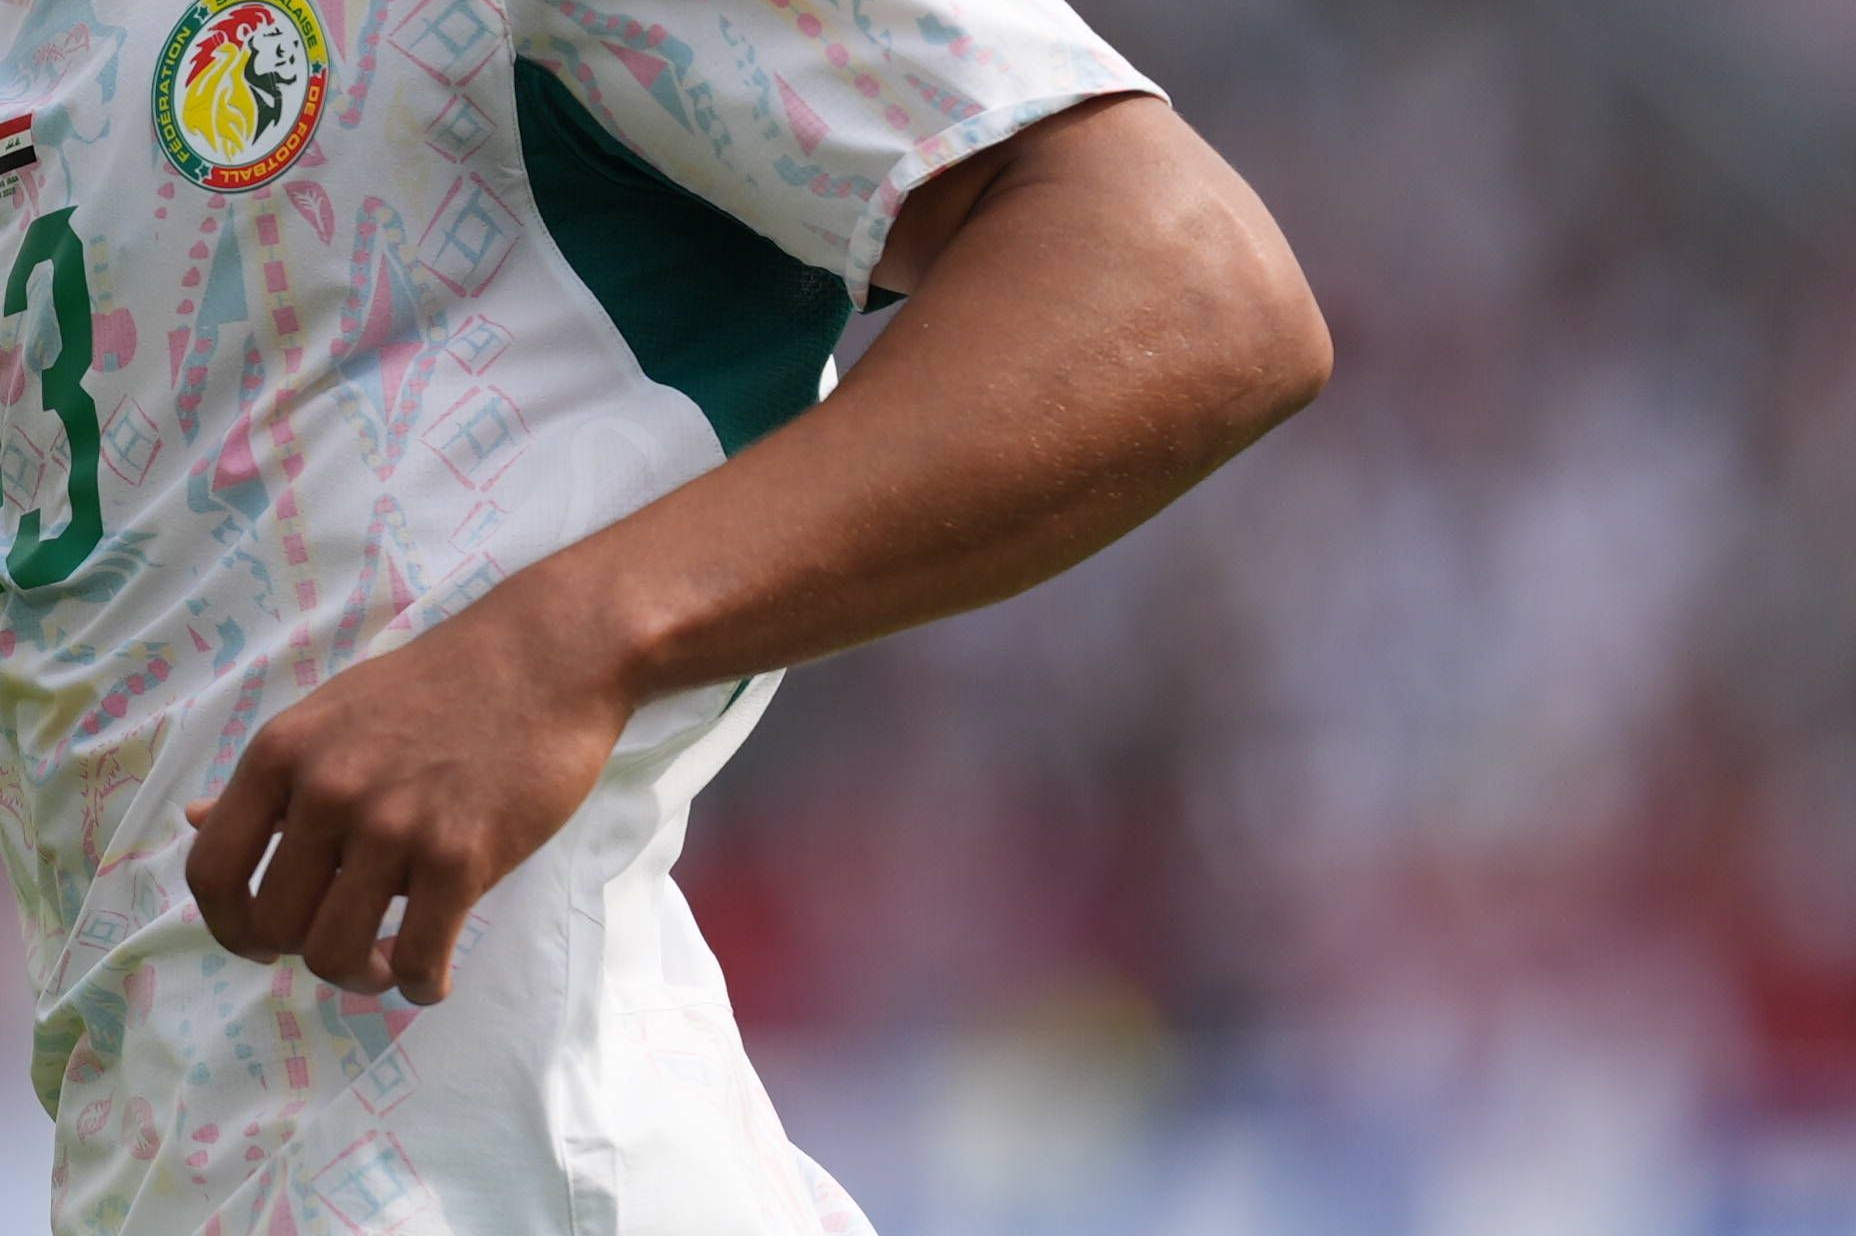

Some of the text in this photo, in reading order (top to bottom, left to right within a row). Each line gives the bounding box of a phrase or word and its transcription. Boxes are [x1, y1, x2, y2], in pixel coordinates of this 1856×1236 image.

[158, 26, 191, 163] FÉDÉRATION
[304, 85, 320, 117] DE
[219, 122, 308, 183] FOOTBALL
